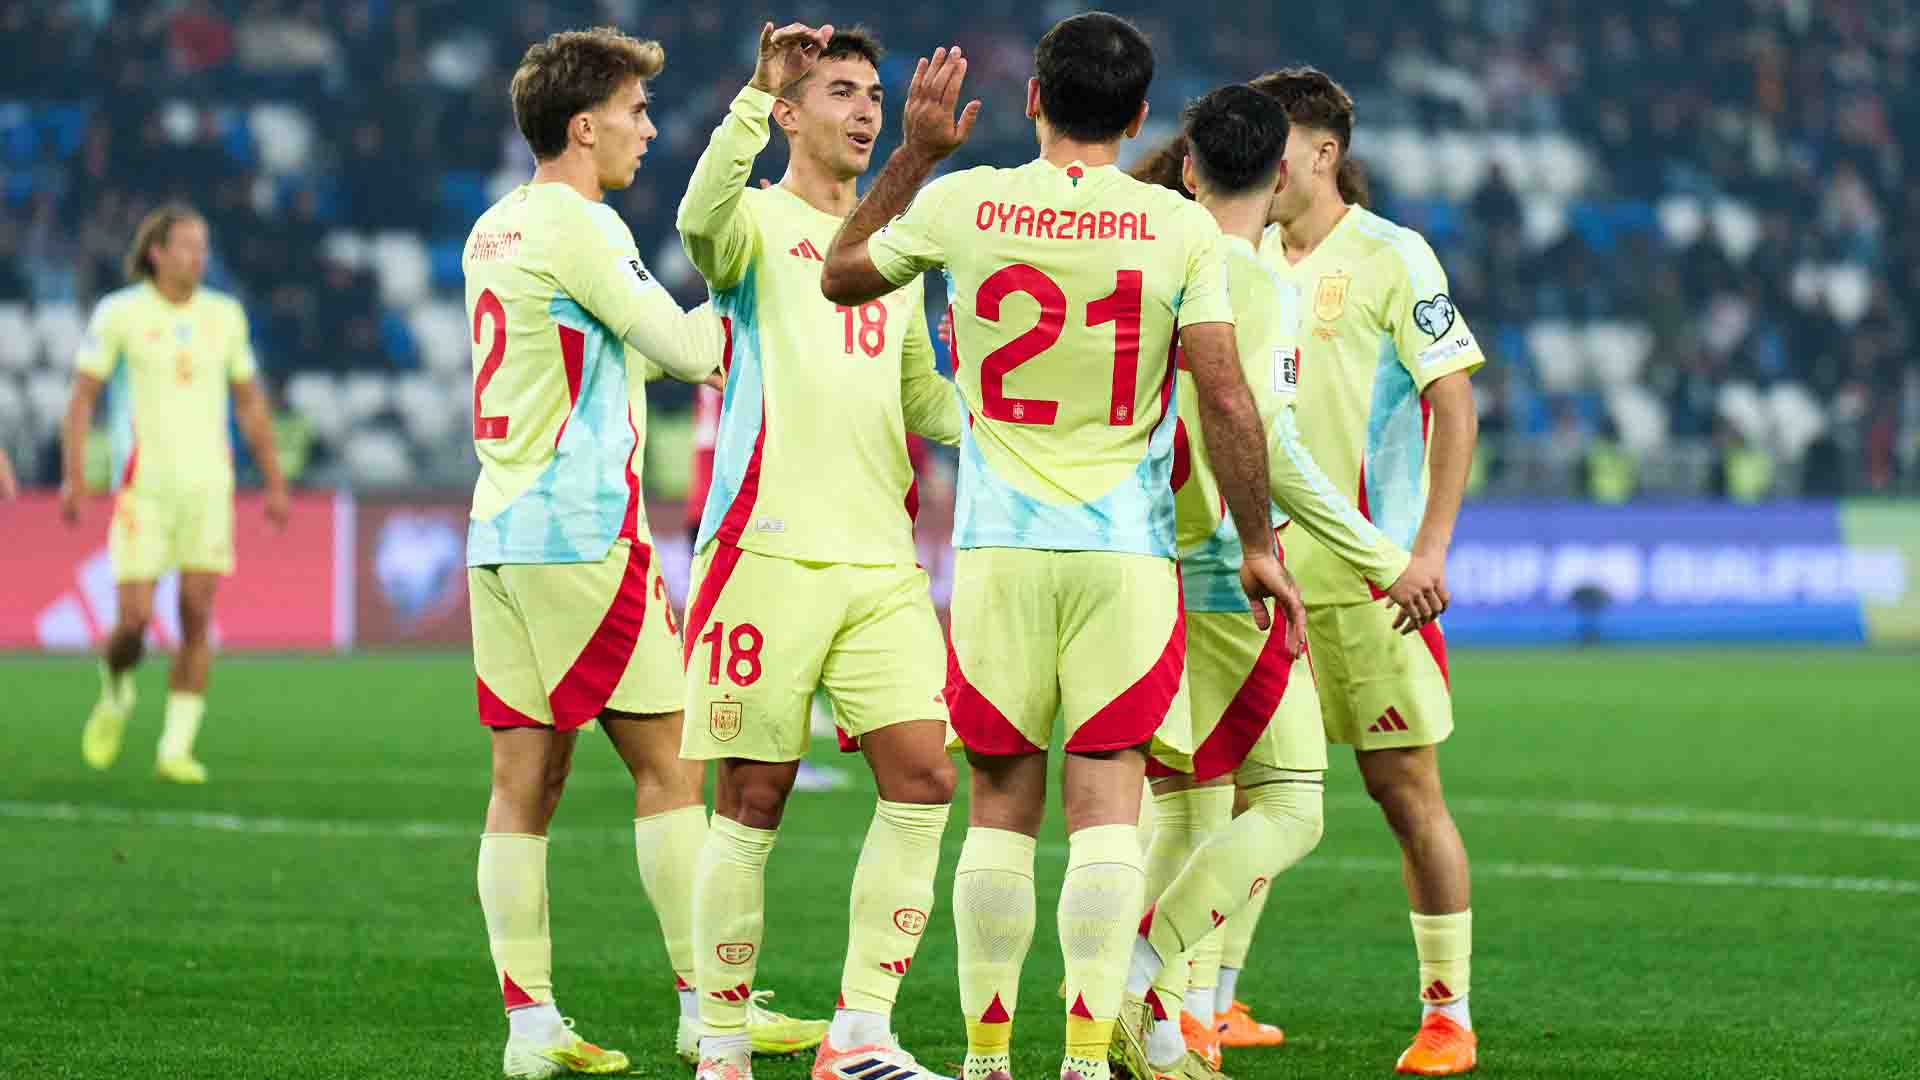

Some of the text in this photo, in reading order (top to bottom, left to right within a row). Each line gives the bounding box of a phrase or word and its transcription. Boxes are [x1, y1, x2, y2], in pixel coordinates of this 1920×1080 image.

[976, 200, 1156, 241] OYARZABAL
[836, 299, 888, 358] 18
[975, 263, 1143, 427] 21
[472, 288, 509, 440] 2
[702, 620, 764, 687] 18
